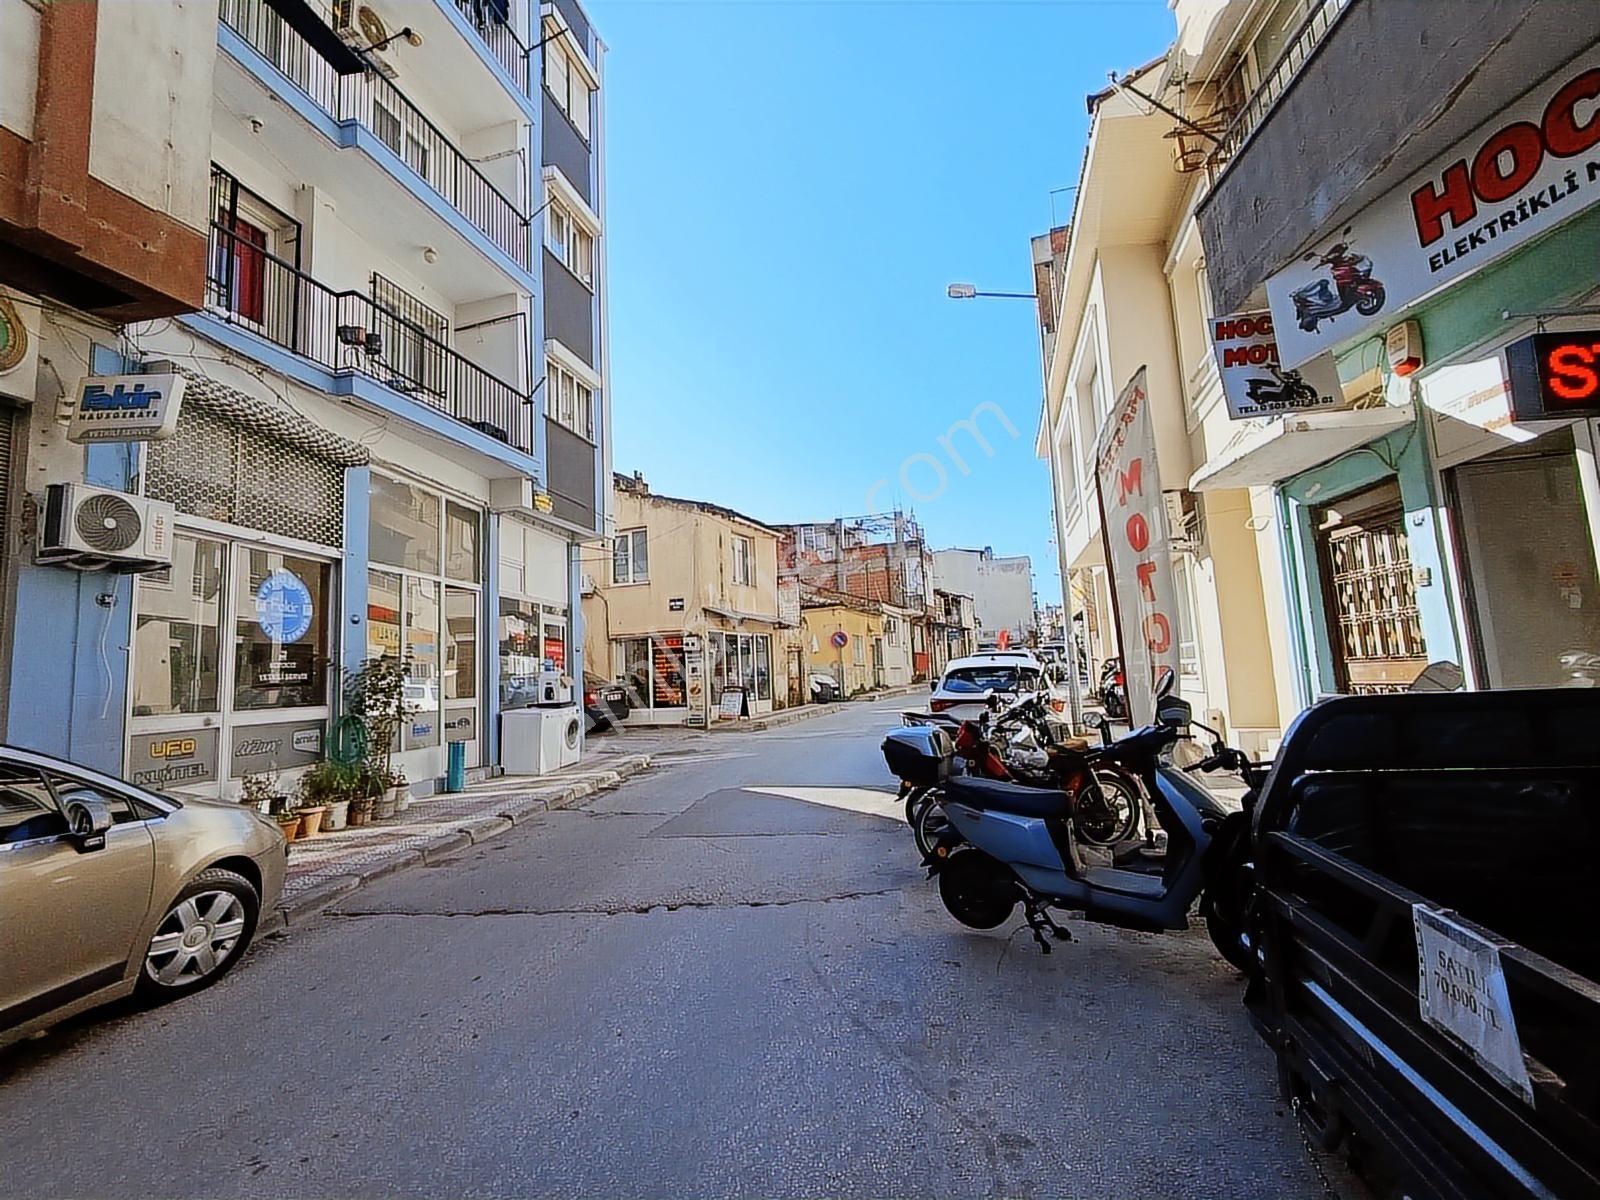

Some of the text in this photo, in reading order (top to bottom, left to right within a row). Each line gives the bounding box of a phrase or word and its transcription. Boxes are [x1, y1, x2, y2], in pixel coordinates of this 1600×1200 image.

[1429, 170, 1579, 273] ELEKTRİKLİ
[1549, 344, 1600, 399] S
[150, 737, 197, 759] UFO
